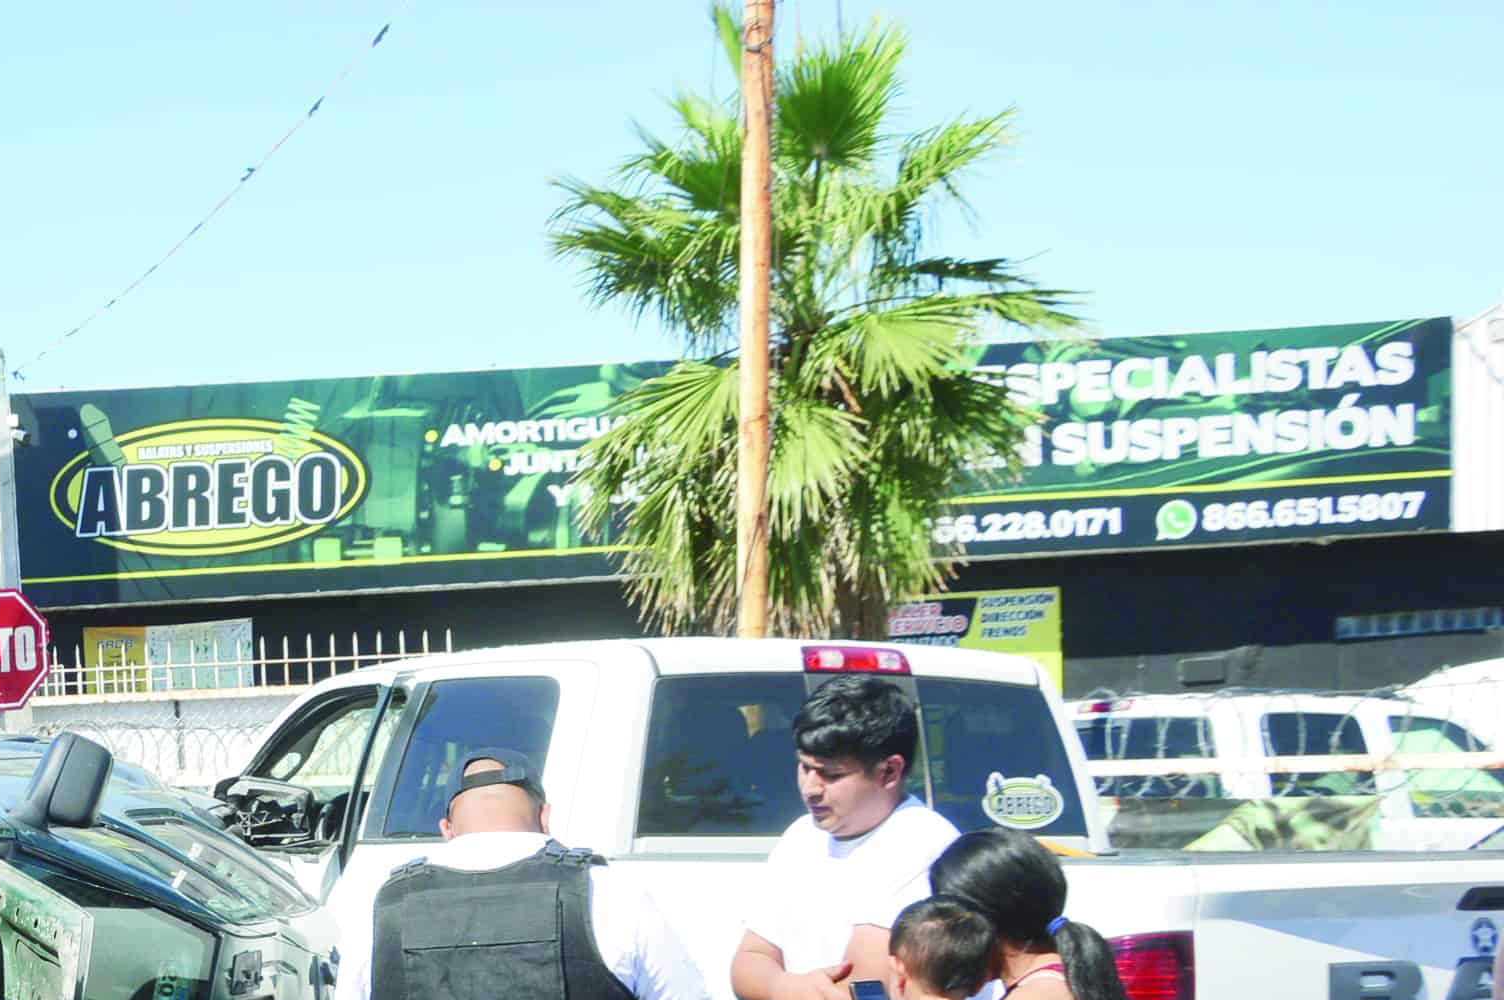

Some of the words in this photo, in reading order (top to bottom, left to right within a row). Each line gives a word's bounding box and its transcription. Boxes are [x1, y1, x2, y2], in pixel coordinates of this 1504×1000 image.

[1051, 393, 1415, 466] SUSPENSIÓN
[76, 452, 344, 538] ABREGO
[922, 507, 1122, 544] 66.228.0171
